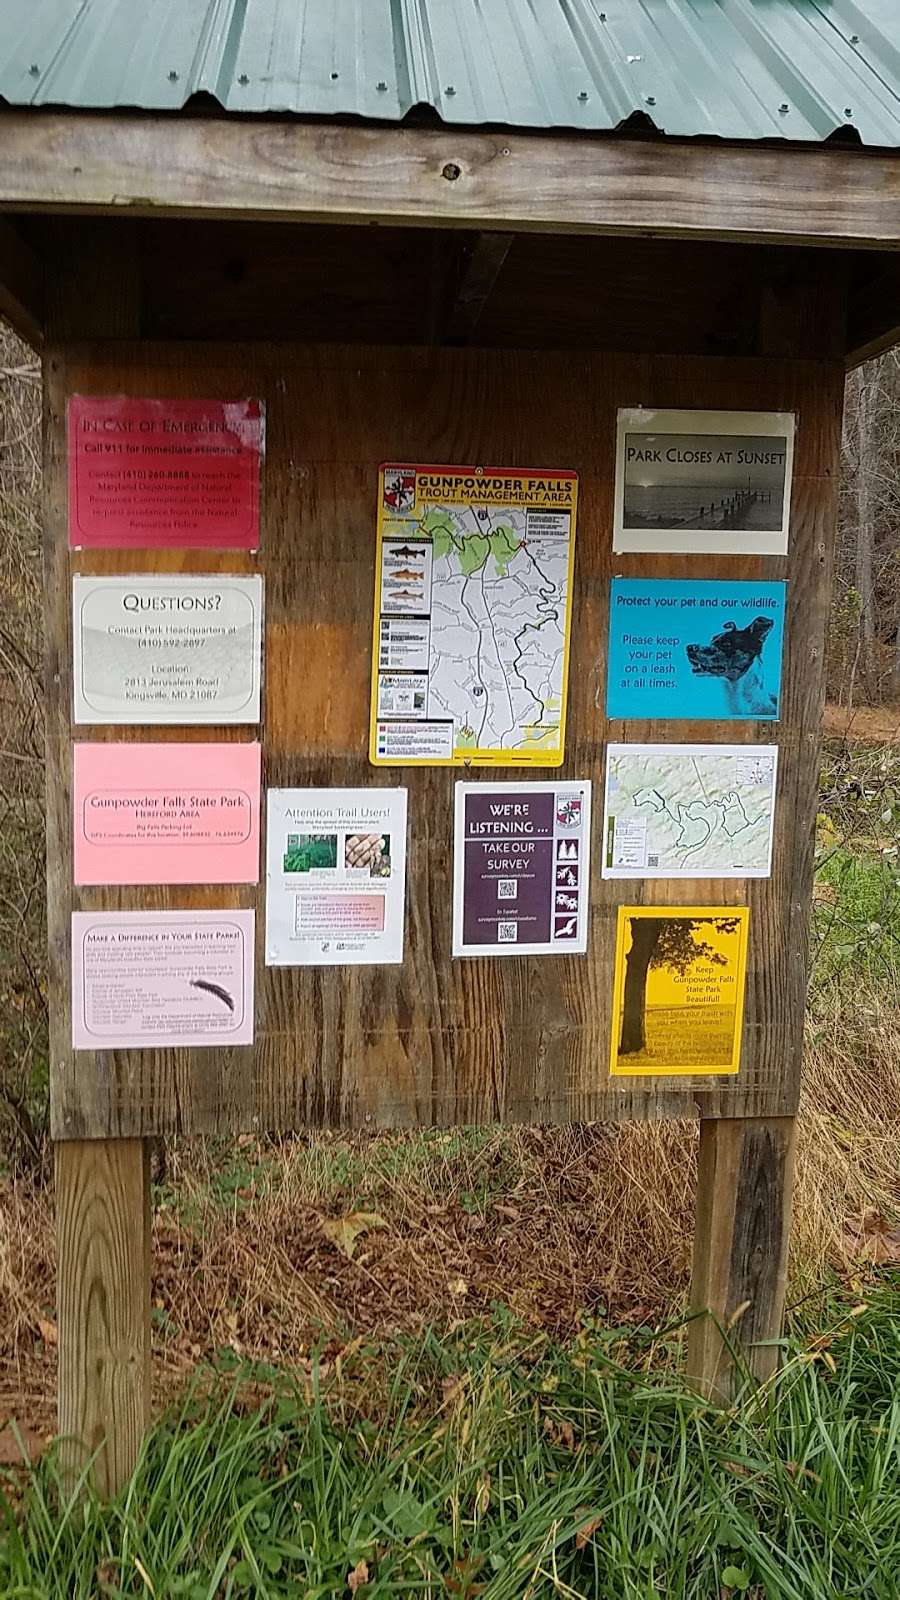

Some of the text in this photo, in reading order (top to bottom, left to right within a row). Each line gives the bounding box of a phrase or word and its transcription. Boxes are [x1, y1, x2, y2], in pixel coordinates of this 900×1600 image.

[84, 444, 102, 453] Call
[104, 445, 123, 453] 911
[126, 444, 139, 453] for
[627, 448, 785, 465] PARK CLOSES AT SUNSET
[123, 470, 146, 480] (410)
[418, 476, 572, 492] GUNPOWDER FALLS
[418, 487, 459, 499] TROUT
[460, 490, 541, 502] MANAGEMENT
[543, 492, 572, 502] AREA
[123, 594, 222, 613] QUESTIONS?
[617, 596, 780, 609] Protect your pet and our wildlife.
[107, 625, 236, 636] Contact Park Headquarters at
[138, 638, 162, 649] (410)
[623, 635, 680, 648] Please keep
[629, 650, 672, 662] your pet
[151, 665, 192, 674] Location:
[624, 664, 676, 674] on a leash
[124, 678, 219, 687] 2813 Jerusalem Road
[620, 678, 678, 689] at all times.
[125, 691, 217, 701] Kingsville, MD 21087
[90, 796, 244, 810] Gunpowder Falls State Park
[135, 810, 200, 819] HEREFORD AREA
[285, 807, 391, 818] Attention Trail Users!
[489, 804, 530, 816] WE'RE
[469, 822, 534, 834] LISTENING
[482, 843, 535, 853] TAKE OUR
[487, 859, 530, 870] SURVEY
[87, 934, 108, 943] MAKE
[111, 935, 116, 943] A
[118, 932, 159, 943] DIFFERENCE
[161, 933, 170, 942] IN
[172, 932, 193, 942] YOUR
[194, 931, 214, 941] STATE
[695, 966, 714, 976] Keep
[673, 976, 735, 986] Gunpowder Falls
[686, 985, 722, 993] State Park
[686, 995, 721, 1003] Beautiful!
